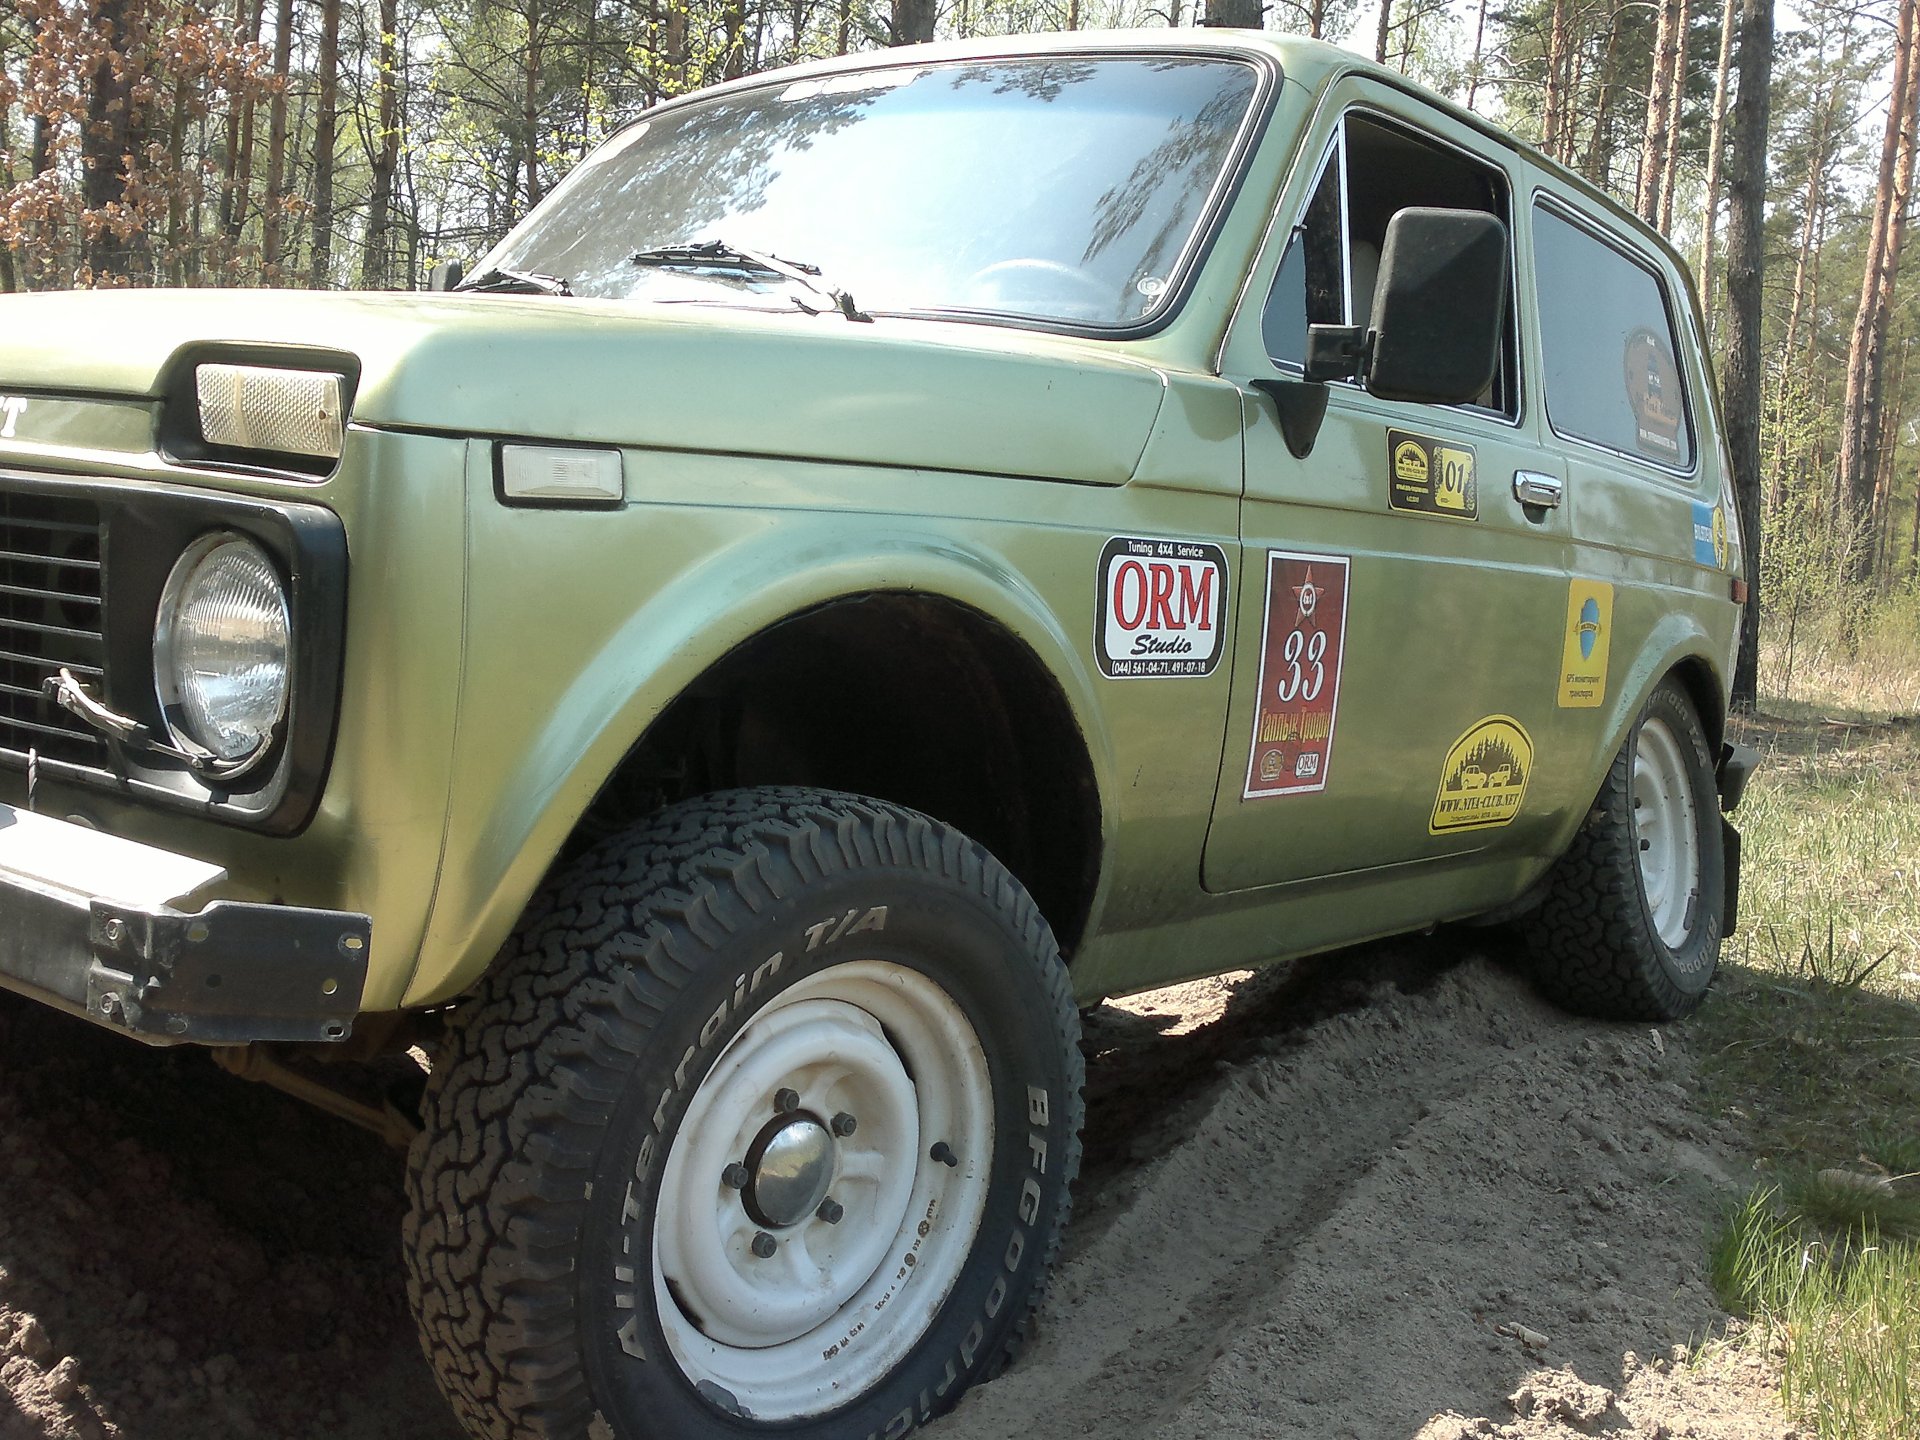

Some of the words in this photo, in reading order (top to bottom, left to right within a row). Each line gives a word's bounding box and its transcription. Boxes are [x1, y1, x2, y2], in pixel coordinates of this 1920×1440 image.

[0, 390, 27, 437] T
[1445, 461, 1464, 494] 01
[1128, 541, 1153, 556] Tuning
[1157, 543, 1173, 556] 4x4
[1177, 545, 1204, 558] Service
[1113, 560, 1215, 631] ORM
[1130, 634, 1192, 656] Studio
[1111, 661, 1131, 675] (044)
[1278, 629, 1328, 702] 33
[1299, 706, 1330, 743] Трофи
[1298, 755, 1318, 770] ORM
[615, 951, 783, 1361] All-Terrain
[804, 905, 888, 953] T/A
[868, 1085, 1050, 1440] BFGoodric
